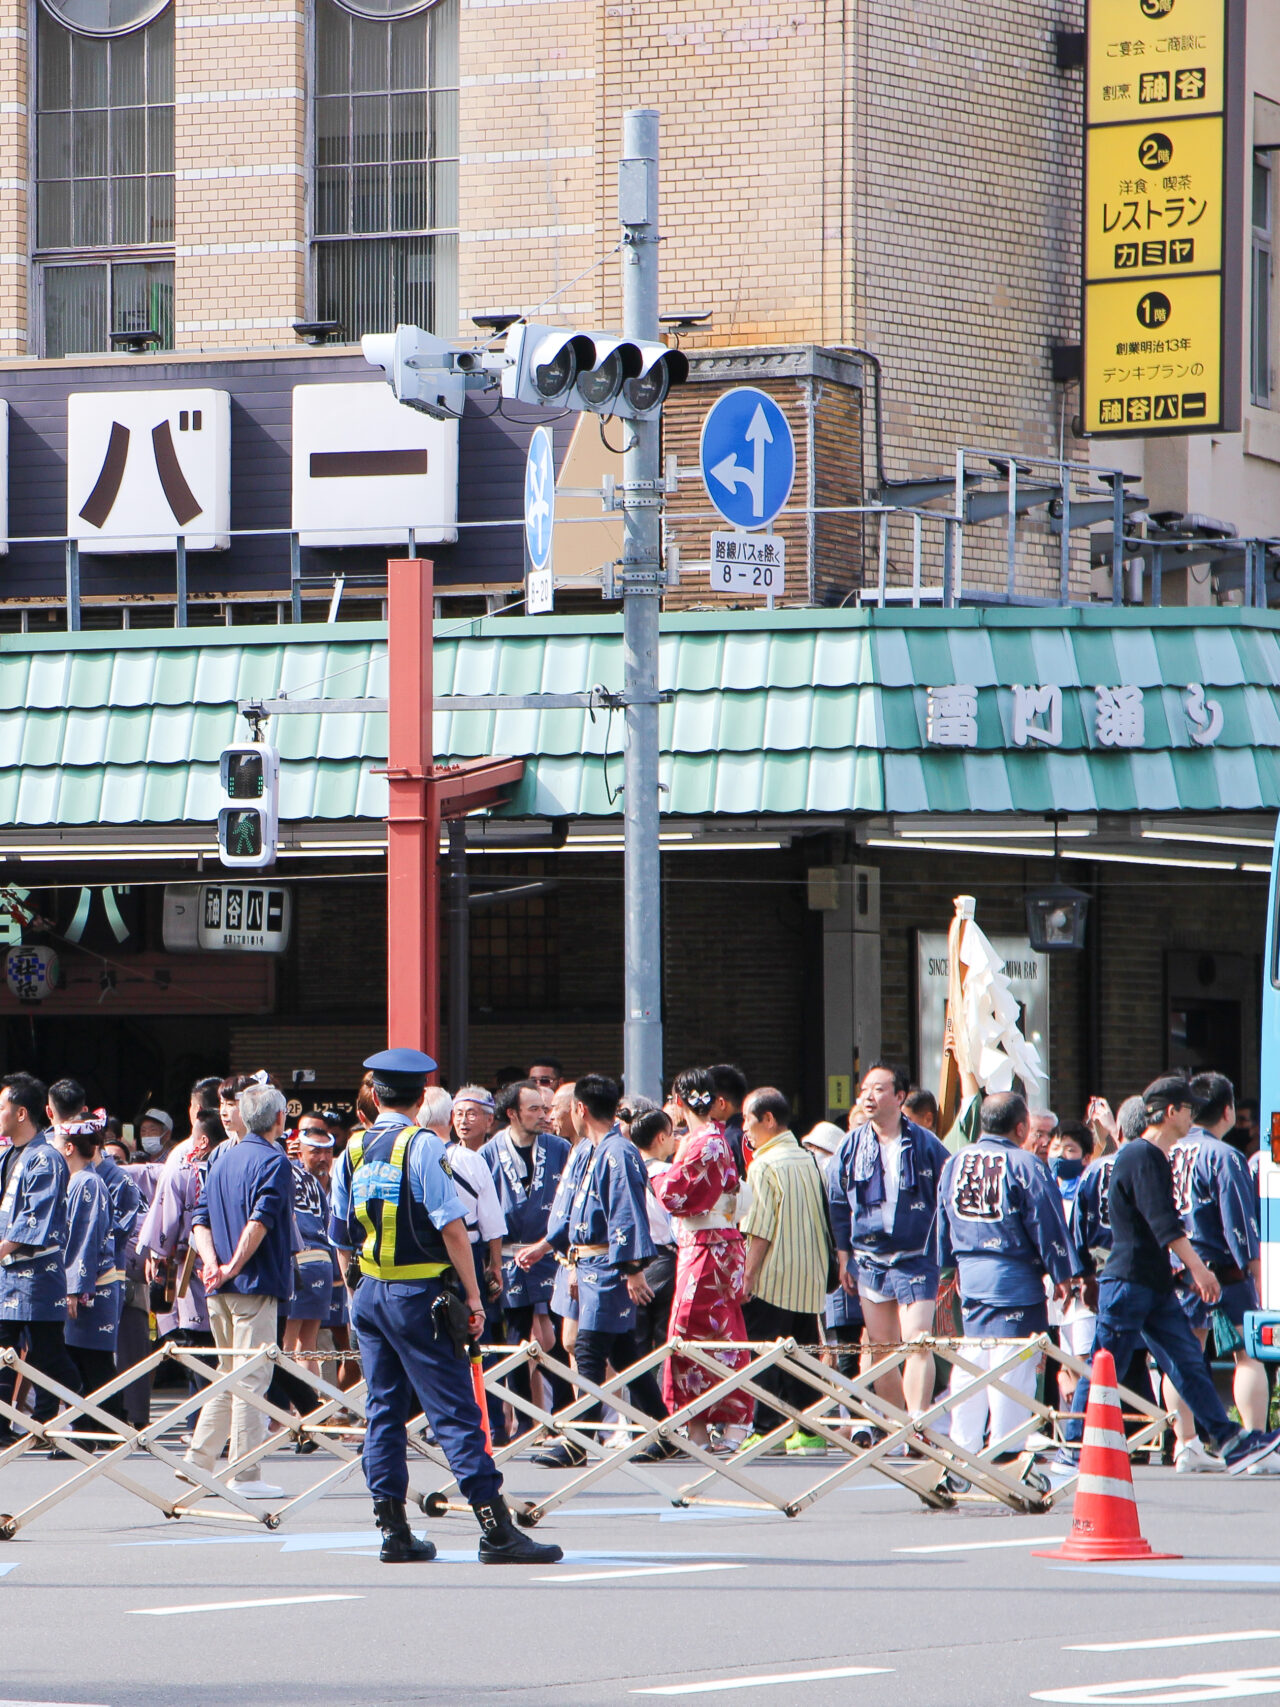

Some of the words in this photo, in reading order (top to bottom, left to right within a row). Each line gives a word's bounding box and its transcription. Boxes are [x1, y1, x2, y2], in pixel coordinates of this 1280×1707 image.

[1140, 70, 1206, 103] 神谷
[1141, 140, 1170, 165] 2階
[1103, 196, 1207, 233] レストラン
[1116, 240, 1192, 267] カミヤ
[1142, 298, 1167, 323] 1階
[1115, 338, 1192, 356] 創業明治13年
[1102, 362, 1205, 383] デンキブランの
[1100, 395, 1206, 423] 神谷バー
[716, 542, 780, 563] 路線バスを除く
[205, 892, 282, 927] 神谷バー
[928, 958, 949, 976] SINCE
[1024, 961, 1038, 980] BAR
